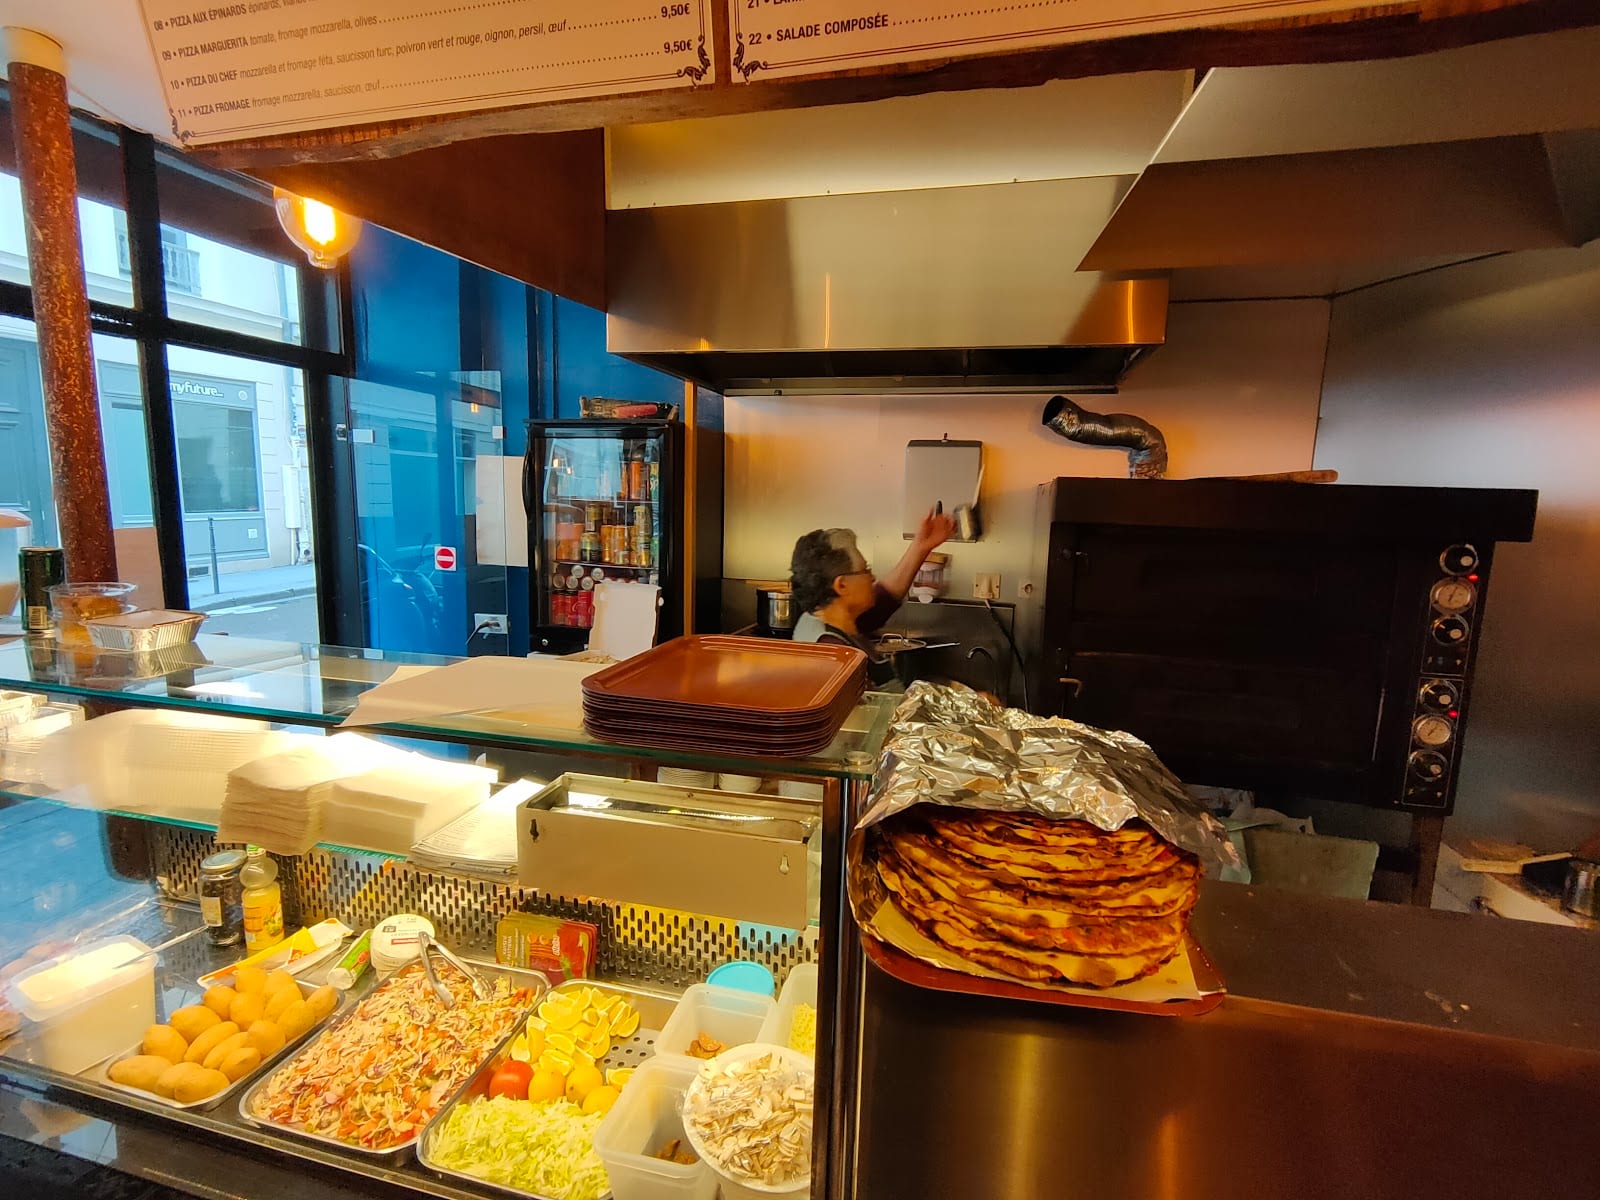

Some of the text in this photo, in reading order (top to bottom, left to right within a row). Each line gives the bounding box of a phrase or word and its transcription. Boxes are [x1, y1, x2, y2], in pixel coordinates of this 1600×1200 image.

[162, 50, 172, 61] 09
[178, 46, 200, 58] PIZZA
[200, 37, 249, 55] MARGUERITA
[278, 26, 308, 40] fromage
[310, 18, 353, 35] mozzarella,
[354, 16, 377, 28] olives
[170, 15, 192, 28] PIZZA
[193, 12, 208, 24] AUX
[208, 4, 247, 21] ÉPINARDS
[749, 12, 889, 45] 22 SALADE COMPOSÉE
[170, 80, 180, 91] 10
[186, 75, 207, 88] PIZZA
[208, 73, 218, 84] DU
[219, 70, 238, 82] CHEF
[240, 64, 277, 79] mozzarella
[278, 63, 286, 73] et
[287, 58, 317, 71] fromage
[336, 50, 375, 64] saucisson
[395, 41, 426, 57] poivron
[427, 37, 444, 50] vert
[445, 37, 455, 48] et
[456, 33, 483, 47] rouge,
[484, 28, 517, 44] oignon,
[518, 22, 546, 40] persil,
[548, 19, 567, 33] œuf
[661, 3, 690, 19] 9,50€
[178, 108, 187, 119] 11
[193, 104, 215, 117] PIZZA
[215, 99, 251, 113] FROMAGE
[252, 95, 280, 109] fromage
[664, 39, 693, 55] 9,50€
